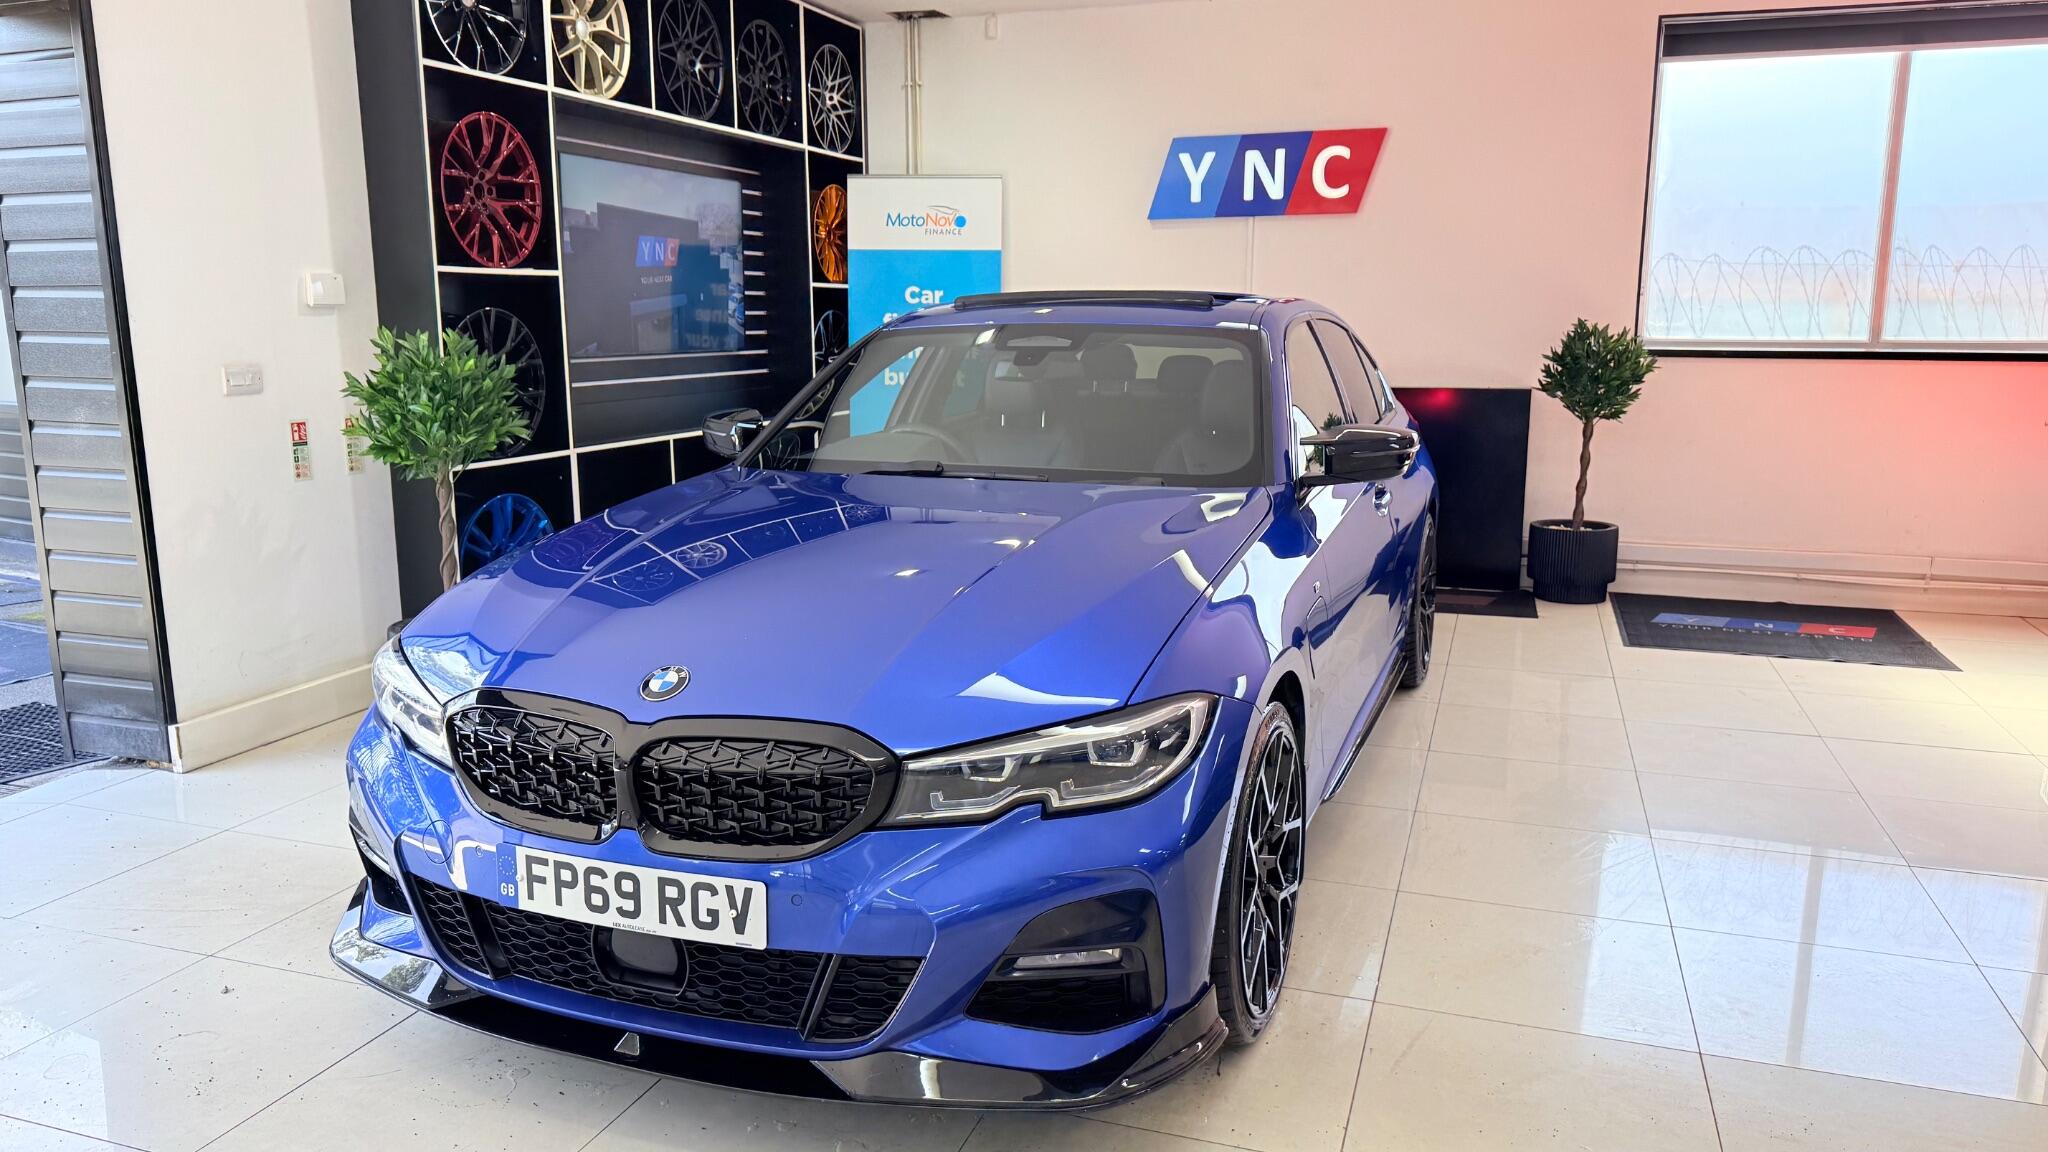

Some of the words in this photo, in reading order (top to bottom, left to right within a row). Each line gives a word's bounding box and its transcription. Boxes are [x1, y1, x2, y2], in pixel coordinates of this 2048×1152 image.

[1178, 145, 1351, 204] YNC
[924, 228, 962, 236] FINANCE
[641, 241, 675, 261] YNC
[904, 286, 944, 305] Car
[500, 882, 515, 897] GB
[525, 854, 642, 919] FP69
[657, 876, 753, 935] RGV
